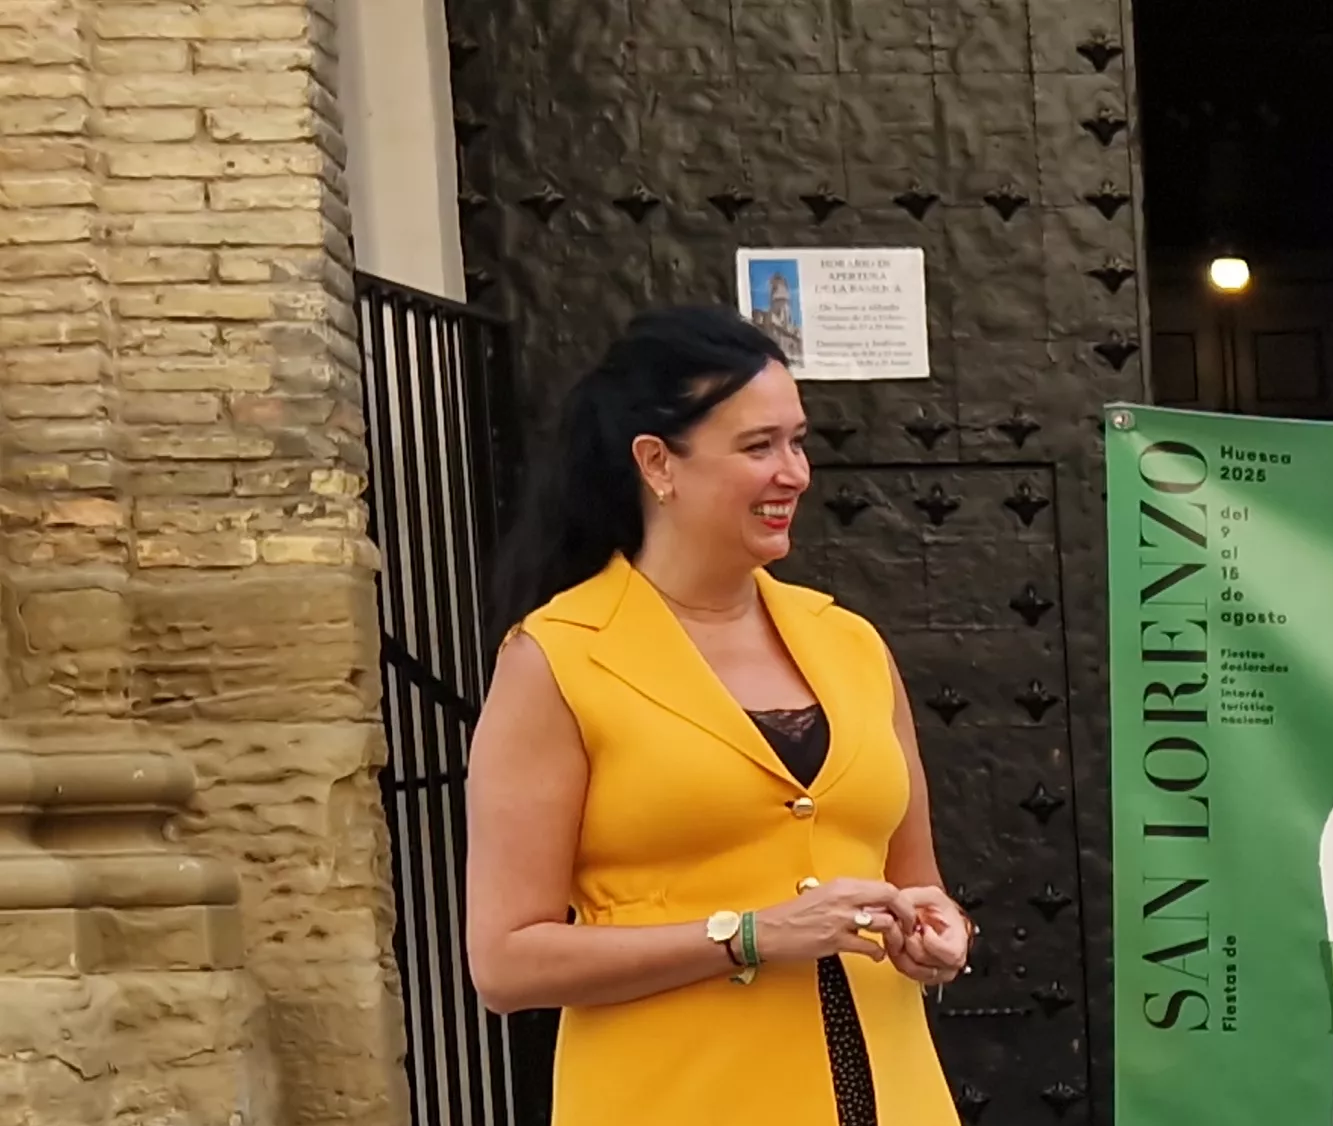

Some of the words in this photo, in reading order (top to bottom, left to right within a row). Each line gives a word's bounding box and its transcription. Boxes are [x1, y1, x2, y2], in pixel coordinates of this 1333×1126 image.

[1220, 445, 1292, 465] Huesca
[1220, 465, 1267, 483] 2025
[1220, 506, 1249, 521] del
[1220, 525, 1231, 538] 9
[1220, 546, 1239, 560] al
[1220, 586, 1245, 602] de
[1220, 609, 1288, 627] agosto
[1138, 440, 1210, 843] LORENZO
[1220, 648, 1266, 660] Fiestas
[1220, 675, 1236, 685] de
[1220, 714, 1274, 726] nacional
[1142, 875, 1210, 1032] SAN
[1221, 934, 1238, 957] de
[1222, 963, 1237, 1032] Fiestas
